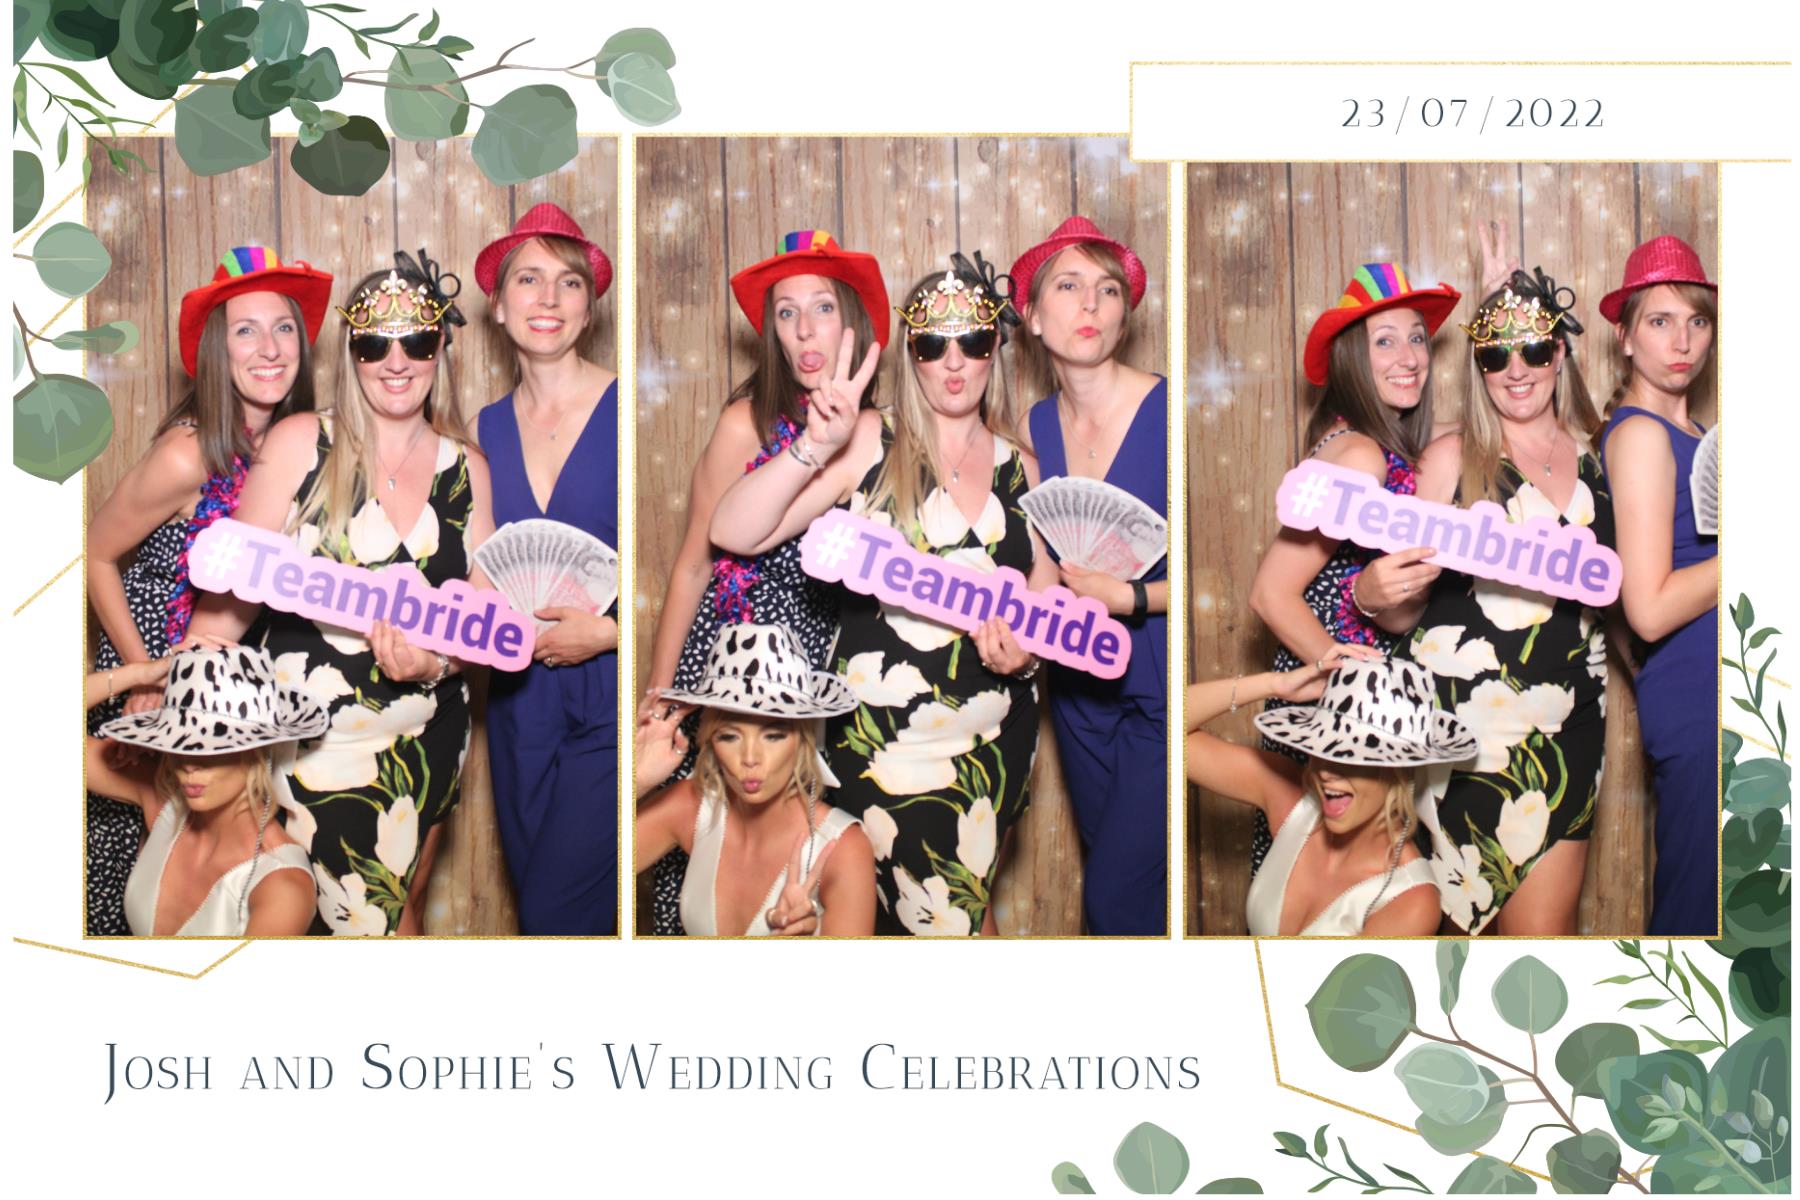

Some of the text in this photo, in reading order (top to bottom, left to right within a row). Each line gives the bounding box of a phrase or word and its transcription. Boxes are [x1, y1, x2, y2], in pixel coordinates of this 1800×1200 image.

[203, 531, 524, 658] #Teambride
[815, 521, 1120, 667] #Teambride
[1290, 471, 1610, 593] #Teambride
